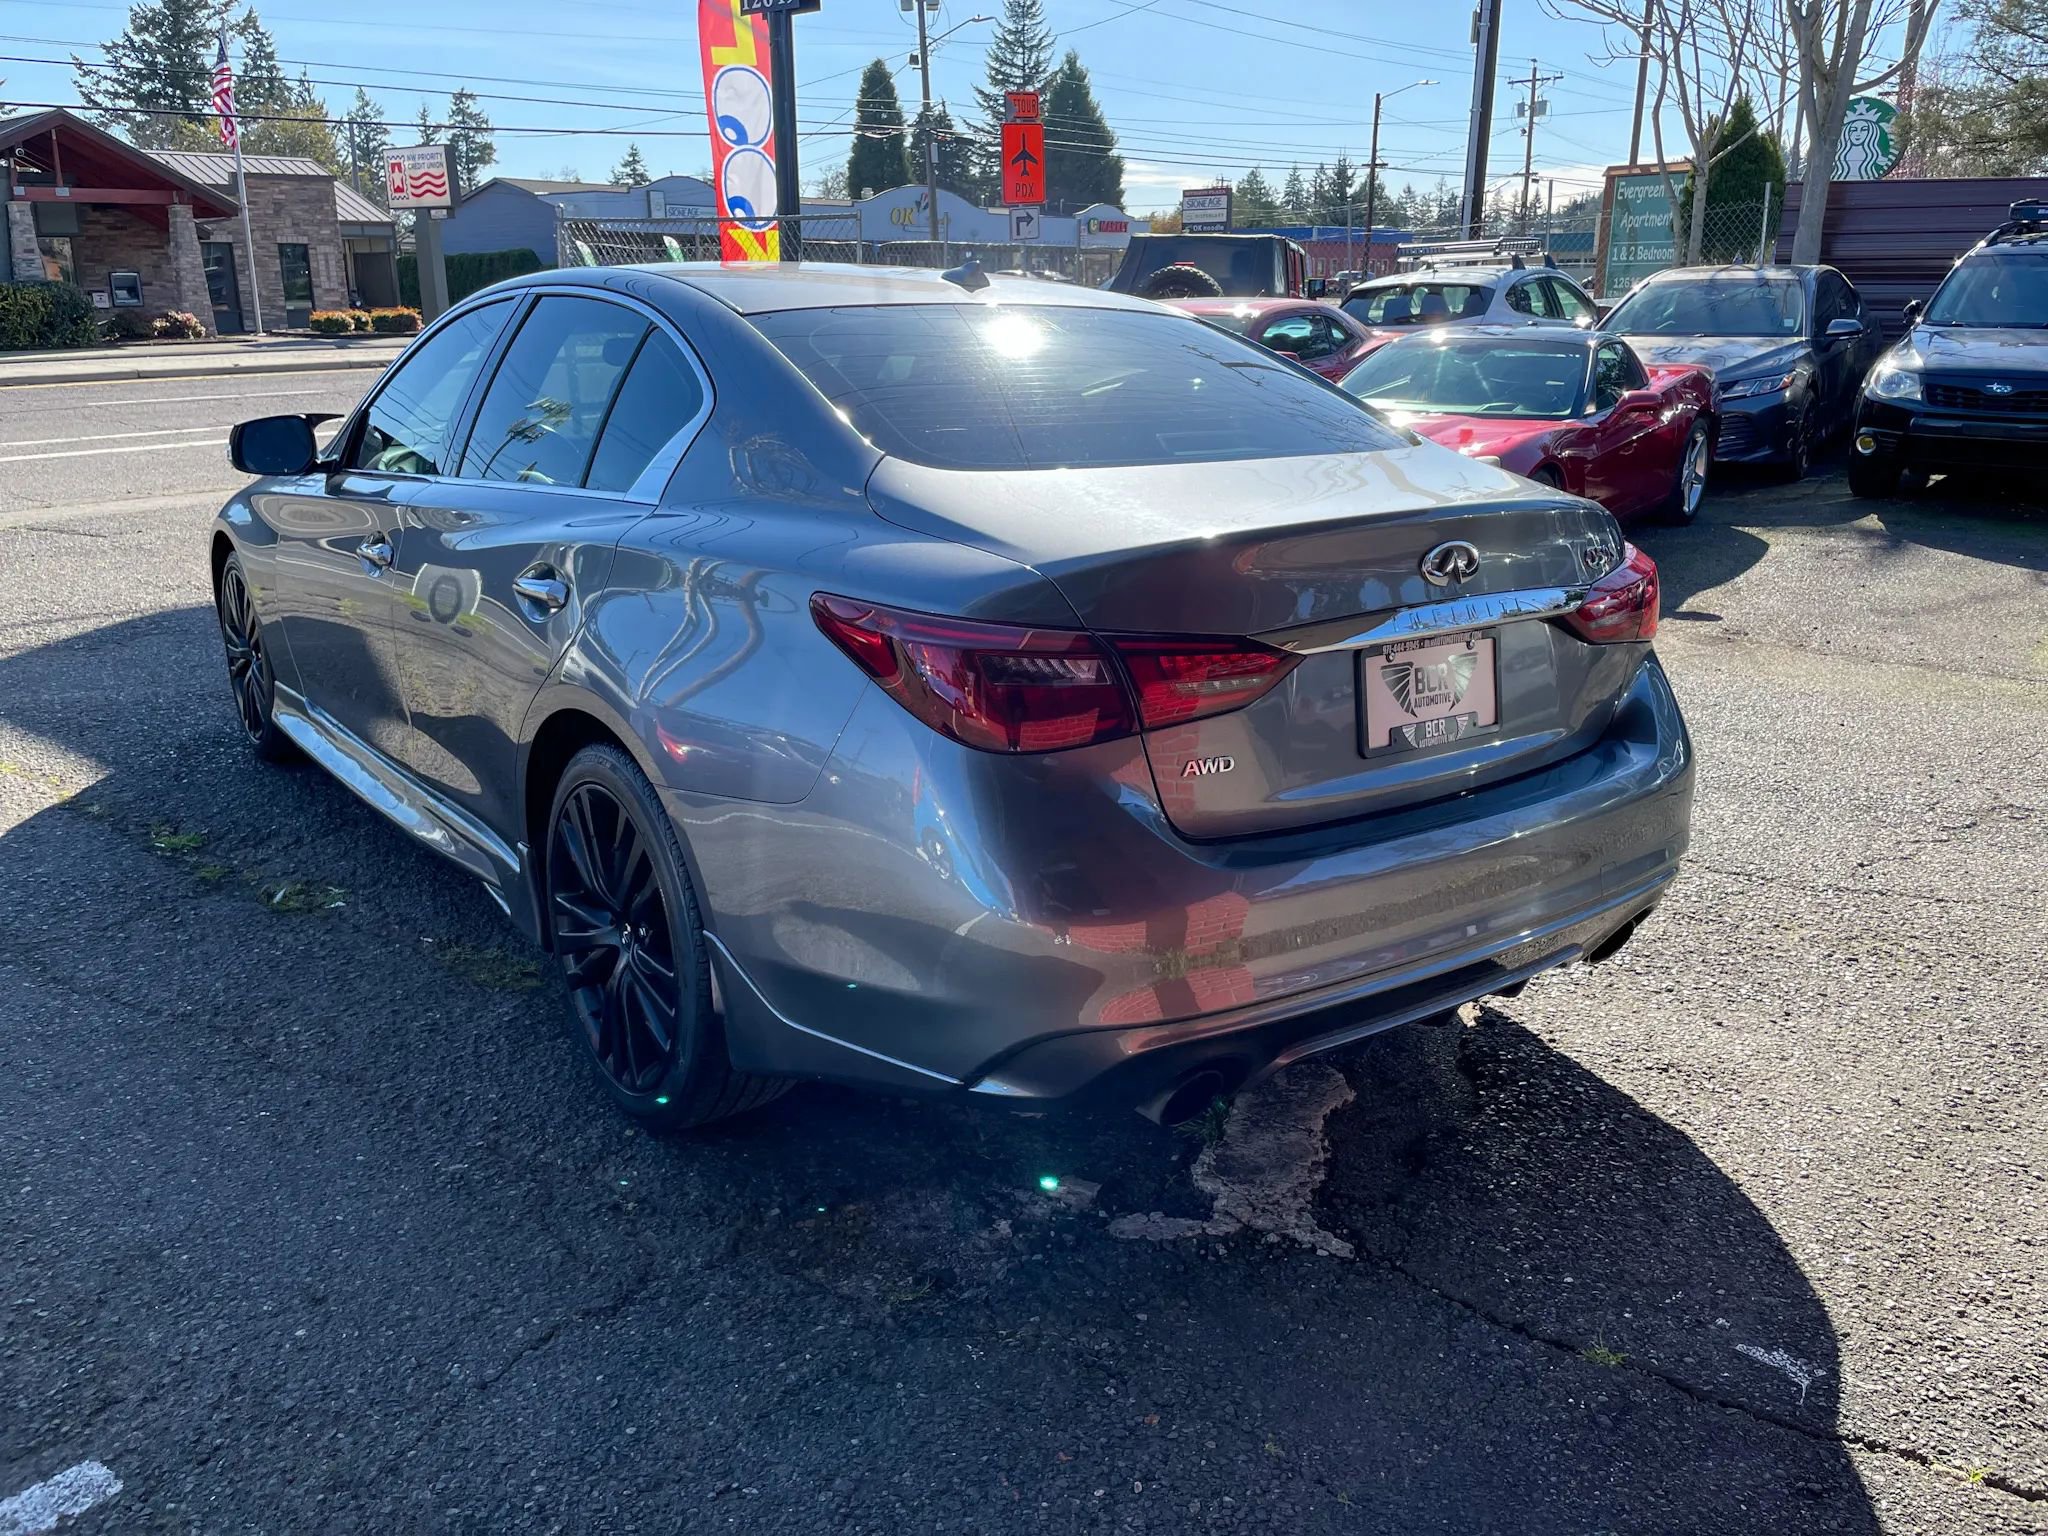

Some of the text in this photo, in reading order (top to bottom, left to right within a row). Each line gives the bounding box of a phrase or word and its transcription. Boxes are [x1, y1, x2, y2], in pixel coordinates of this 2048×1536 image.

[1015, 183, 1034, 198] PDX
[1617, 181, 1665, 204] Evergreen
[890, 207, 915, 226] OK
[1099, 220, 1129, 233] MARKET
[1612, 248, 1618, 260] 1
[1620, 246, 1628, 260] &
[1628, 247, 1635, 260] 2
[1414, 663, 1449, 695] BCR
[1413, 692, 1452, 709] AUTOMOTIVE
[1425, 718, 1447, 738] BCR
[1418, 734, 1448, 749] AUTOMOTIVE
[1181, 756, 1236, 778] AWD
